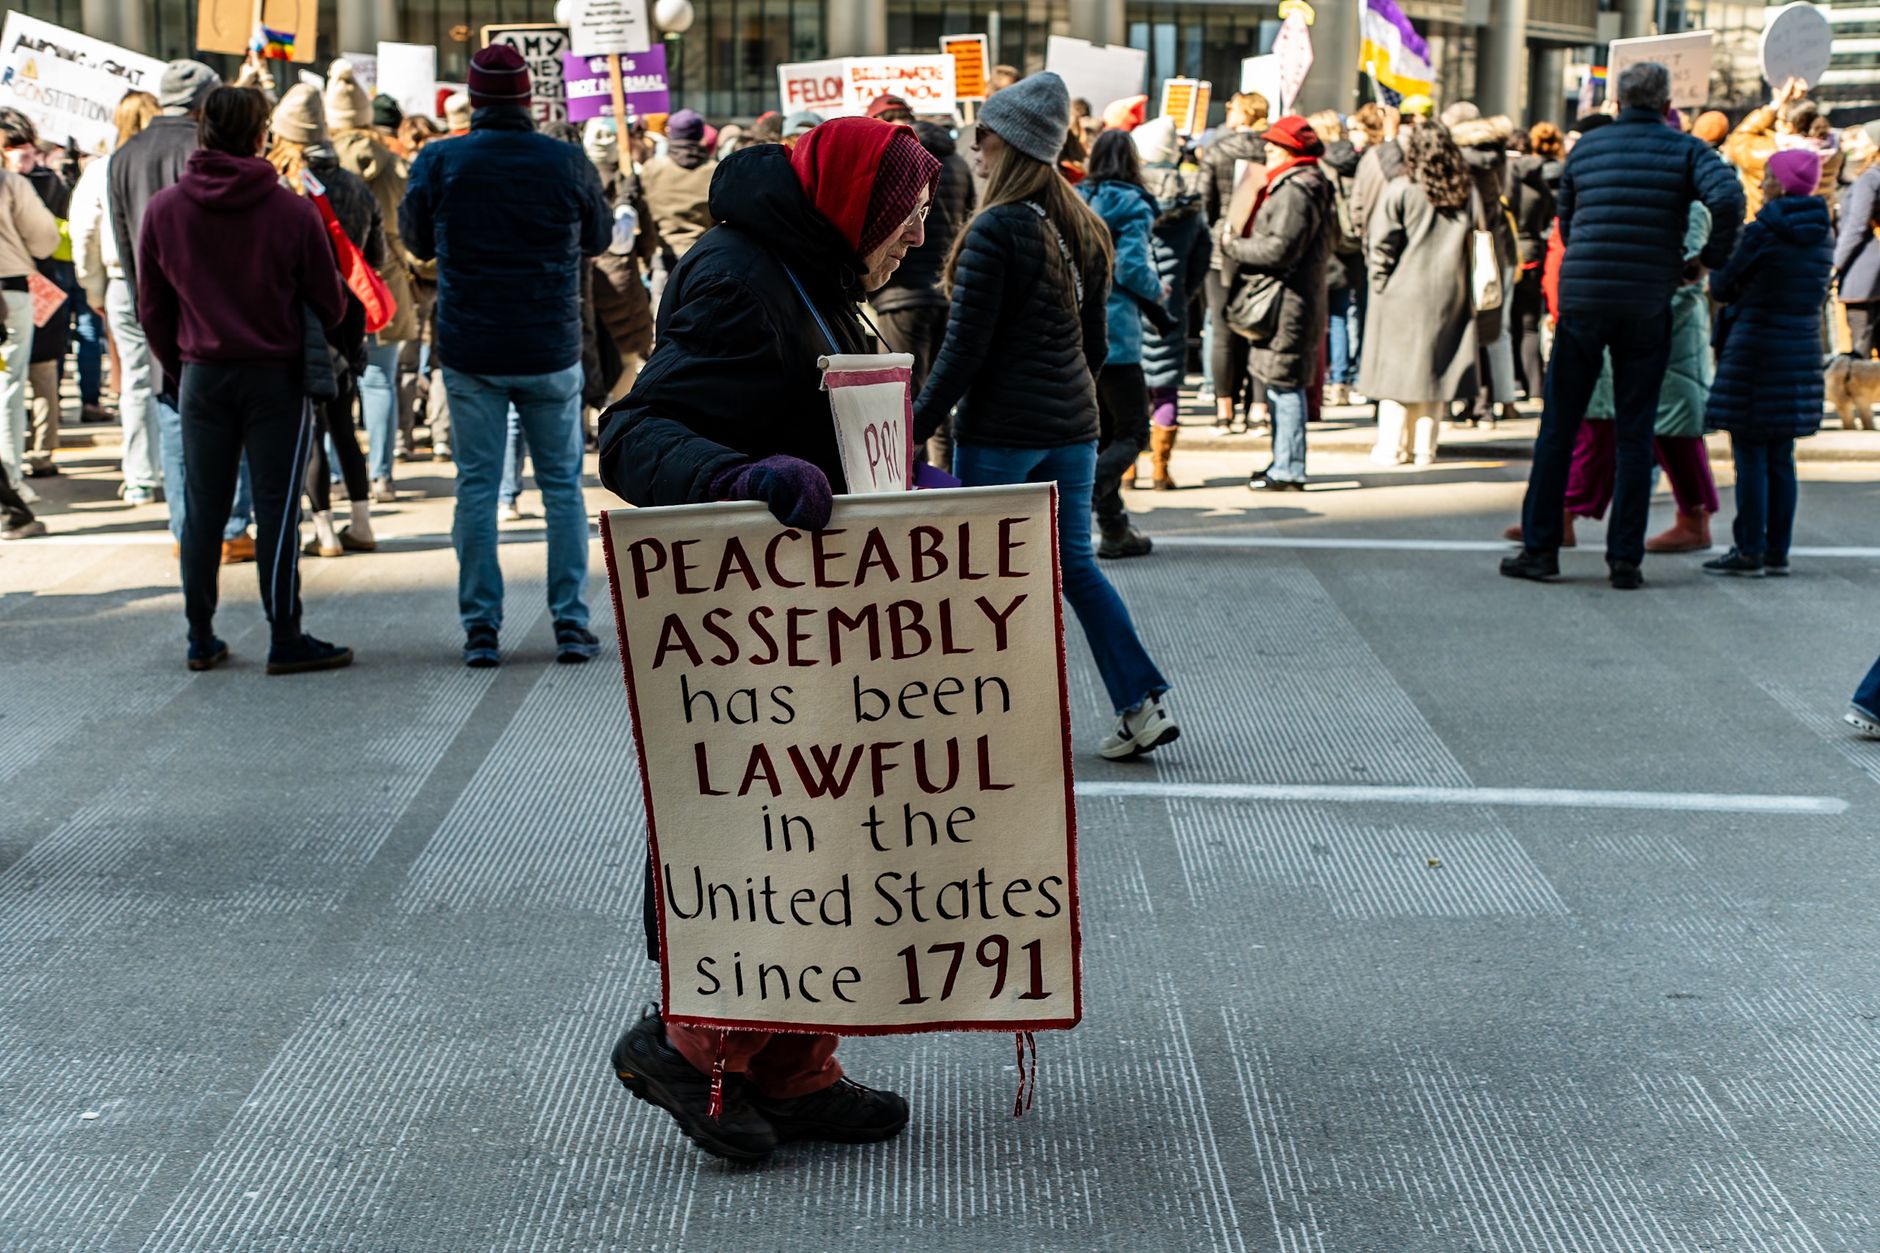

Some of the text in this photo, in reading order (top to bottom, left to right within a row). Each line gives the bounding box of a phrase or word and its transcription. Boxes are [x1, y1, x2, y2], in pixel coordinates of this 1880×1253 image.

[599, 75, 666, 94] NRMAL
[627, 516, 1032, 599] PEACEABLE
[652, 594, 1029, 669] ASSEMBLY
[680, 674, 1010, 725] has been
[694, 734, 1015, 800] LAWFUL
[761, 802, 976, 853] in the
[664, 863, 1063, 927] United States
[696, 933, 1053, 1004] since 1791
